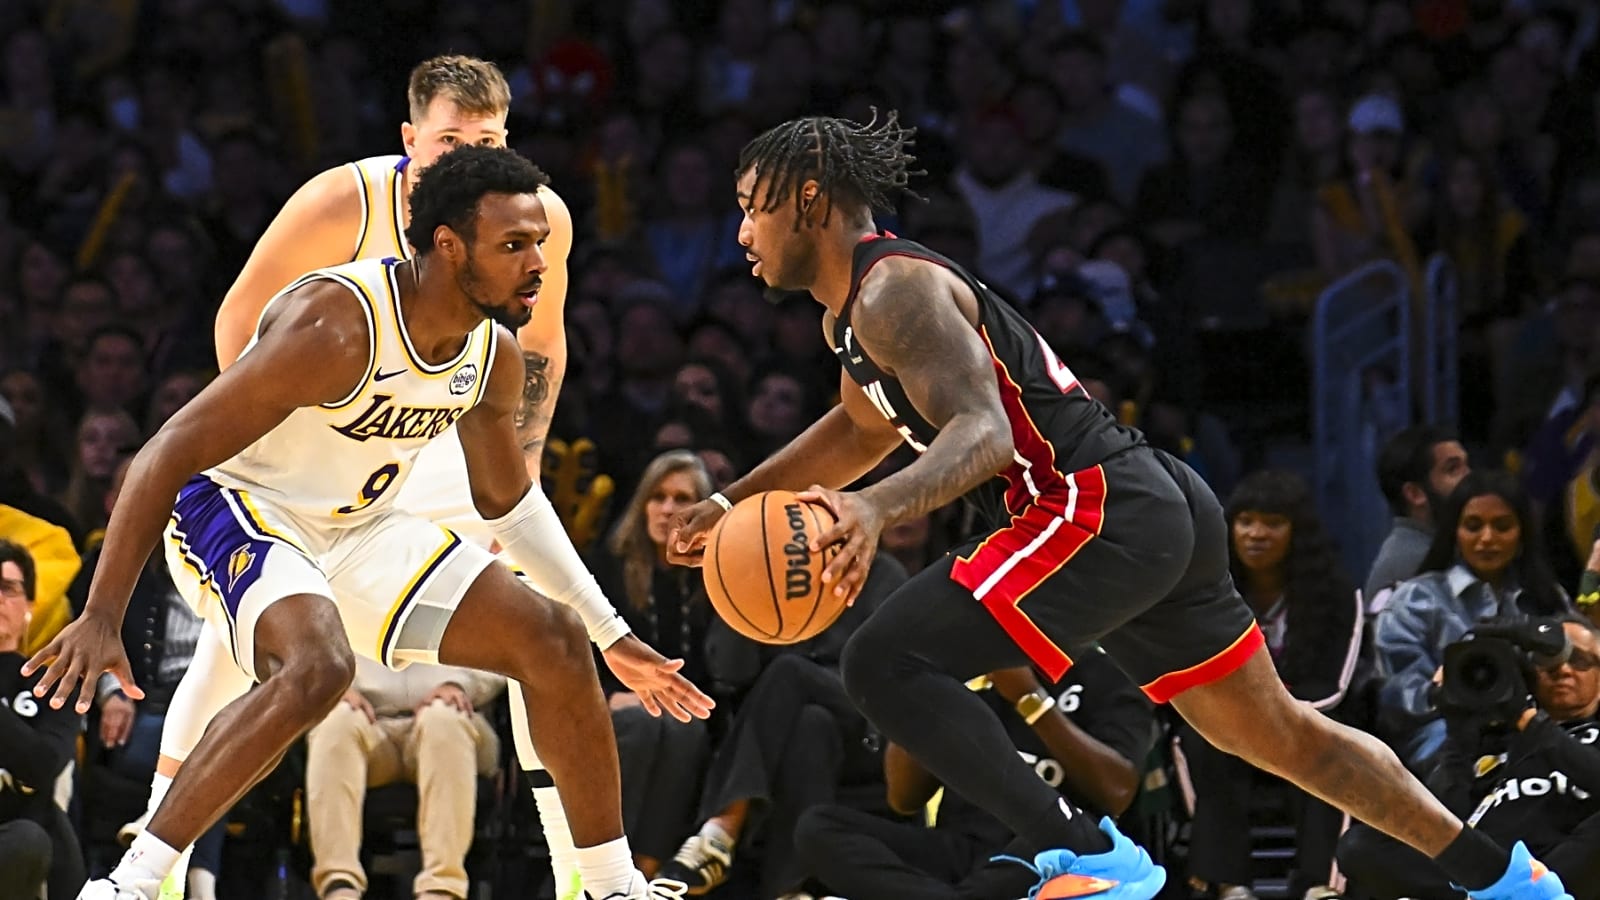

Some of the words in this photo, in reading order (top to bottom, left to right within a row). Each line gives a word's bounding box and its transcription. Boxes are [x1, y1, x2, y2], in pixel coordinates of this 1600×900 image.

[329, 394, 464, 442] LAKERS
[334, 462, 400, 515] 9
[784, 503, 812, 601] Wilson
[1, 690, 38, 717] 6
